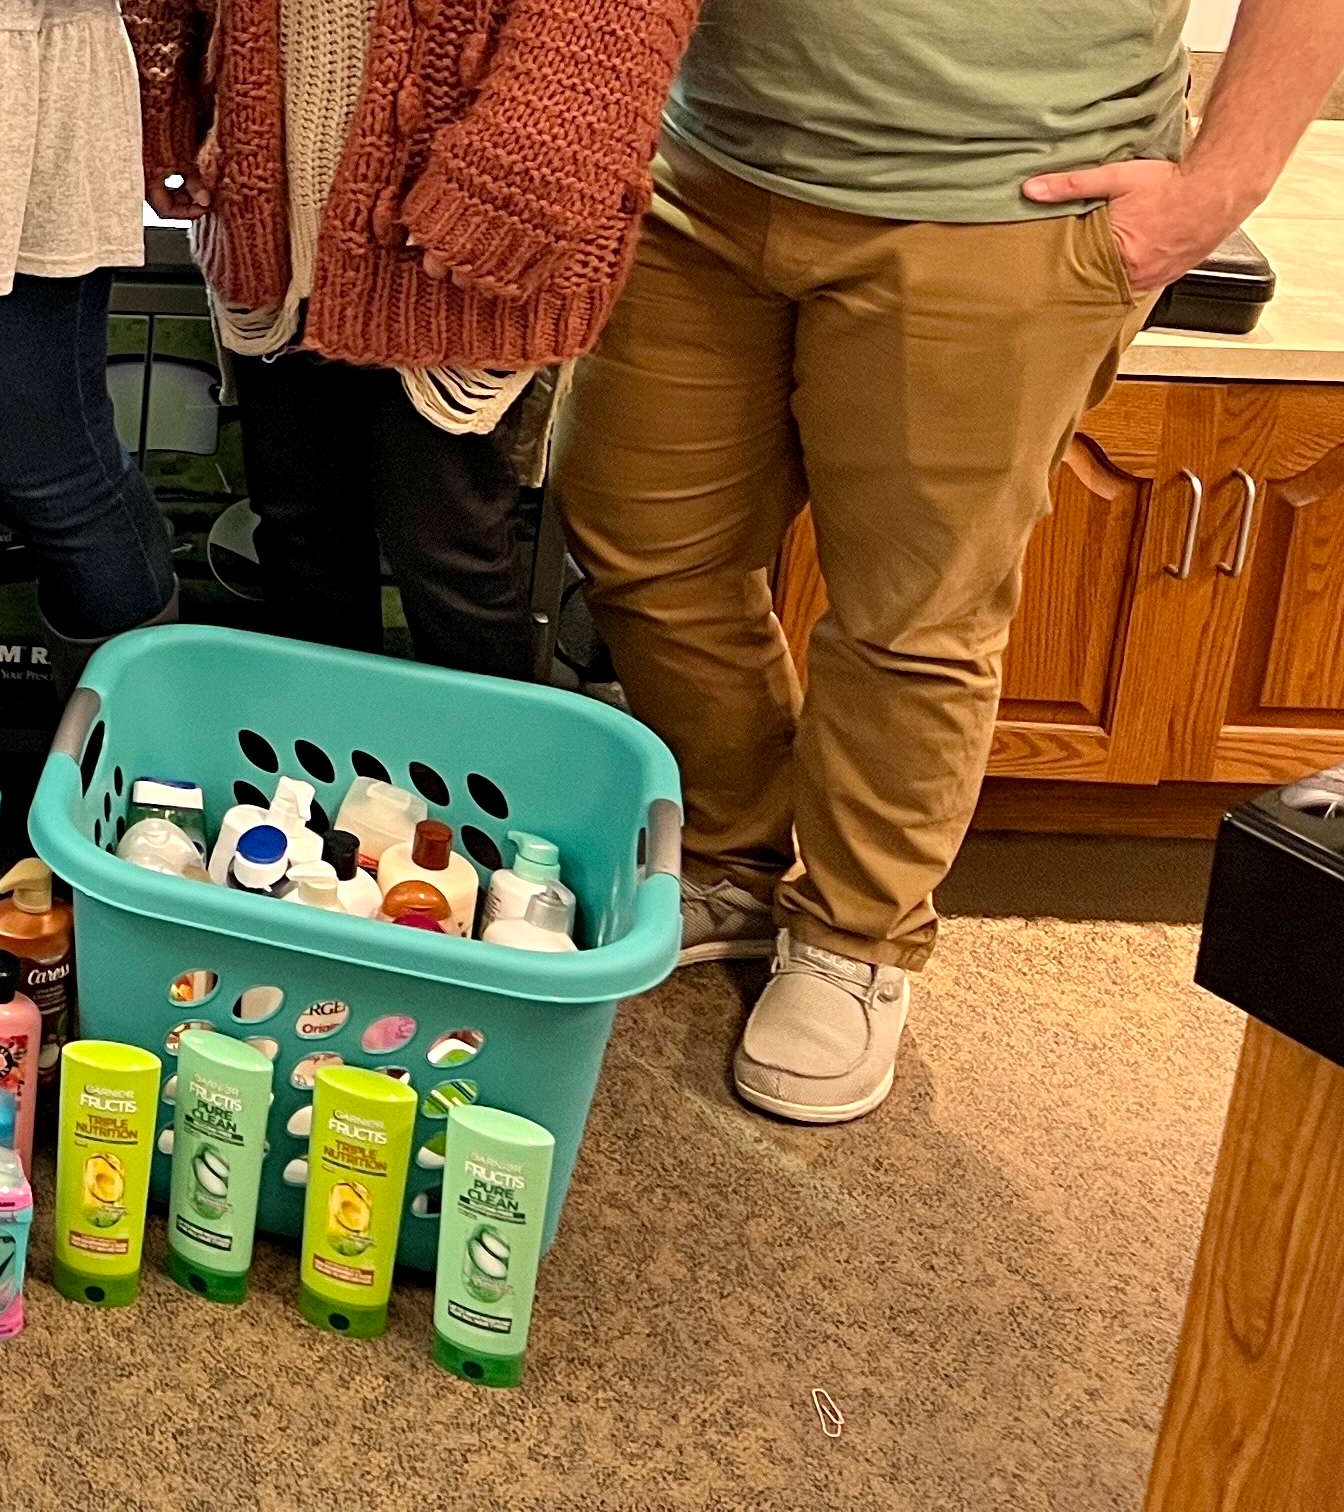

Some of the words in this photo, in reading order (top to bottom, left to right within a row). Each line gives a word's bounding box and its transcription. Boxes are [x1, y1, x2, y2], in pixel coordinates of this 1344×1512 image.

[27, 963, 70, 986] Caress
[80, 1094, 137, 1113] FRUCTIS
[189, 1081, 242, 1112] FRUCTIS
[191, 1107, 238, 1133] CLEAN
[196, 1098, 234, 1120] PURE
[75, 1121, 139, 1139] NUTRITION
[87, 1114, 129, 1129] TRIPLE
[328, 1119, 389, 1145] FRUCTIS
[323, 1146, 388, 1172] NUTRITION
[335, 1139, 378, 1159] TRIPLE
[464, 1160, 526, 1190] FRUCTIS
[467, 1188, 519, 1212] CLEAN
[473, 1178, 516, 1201] PURE
